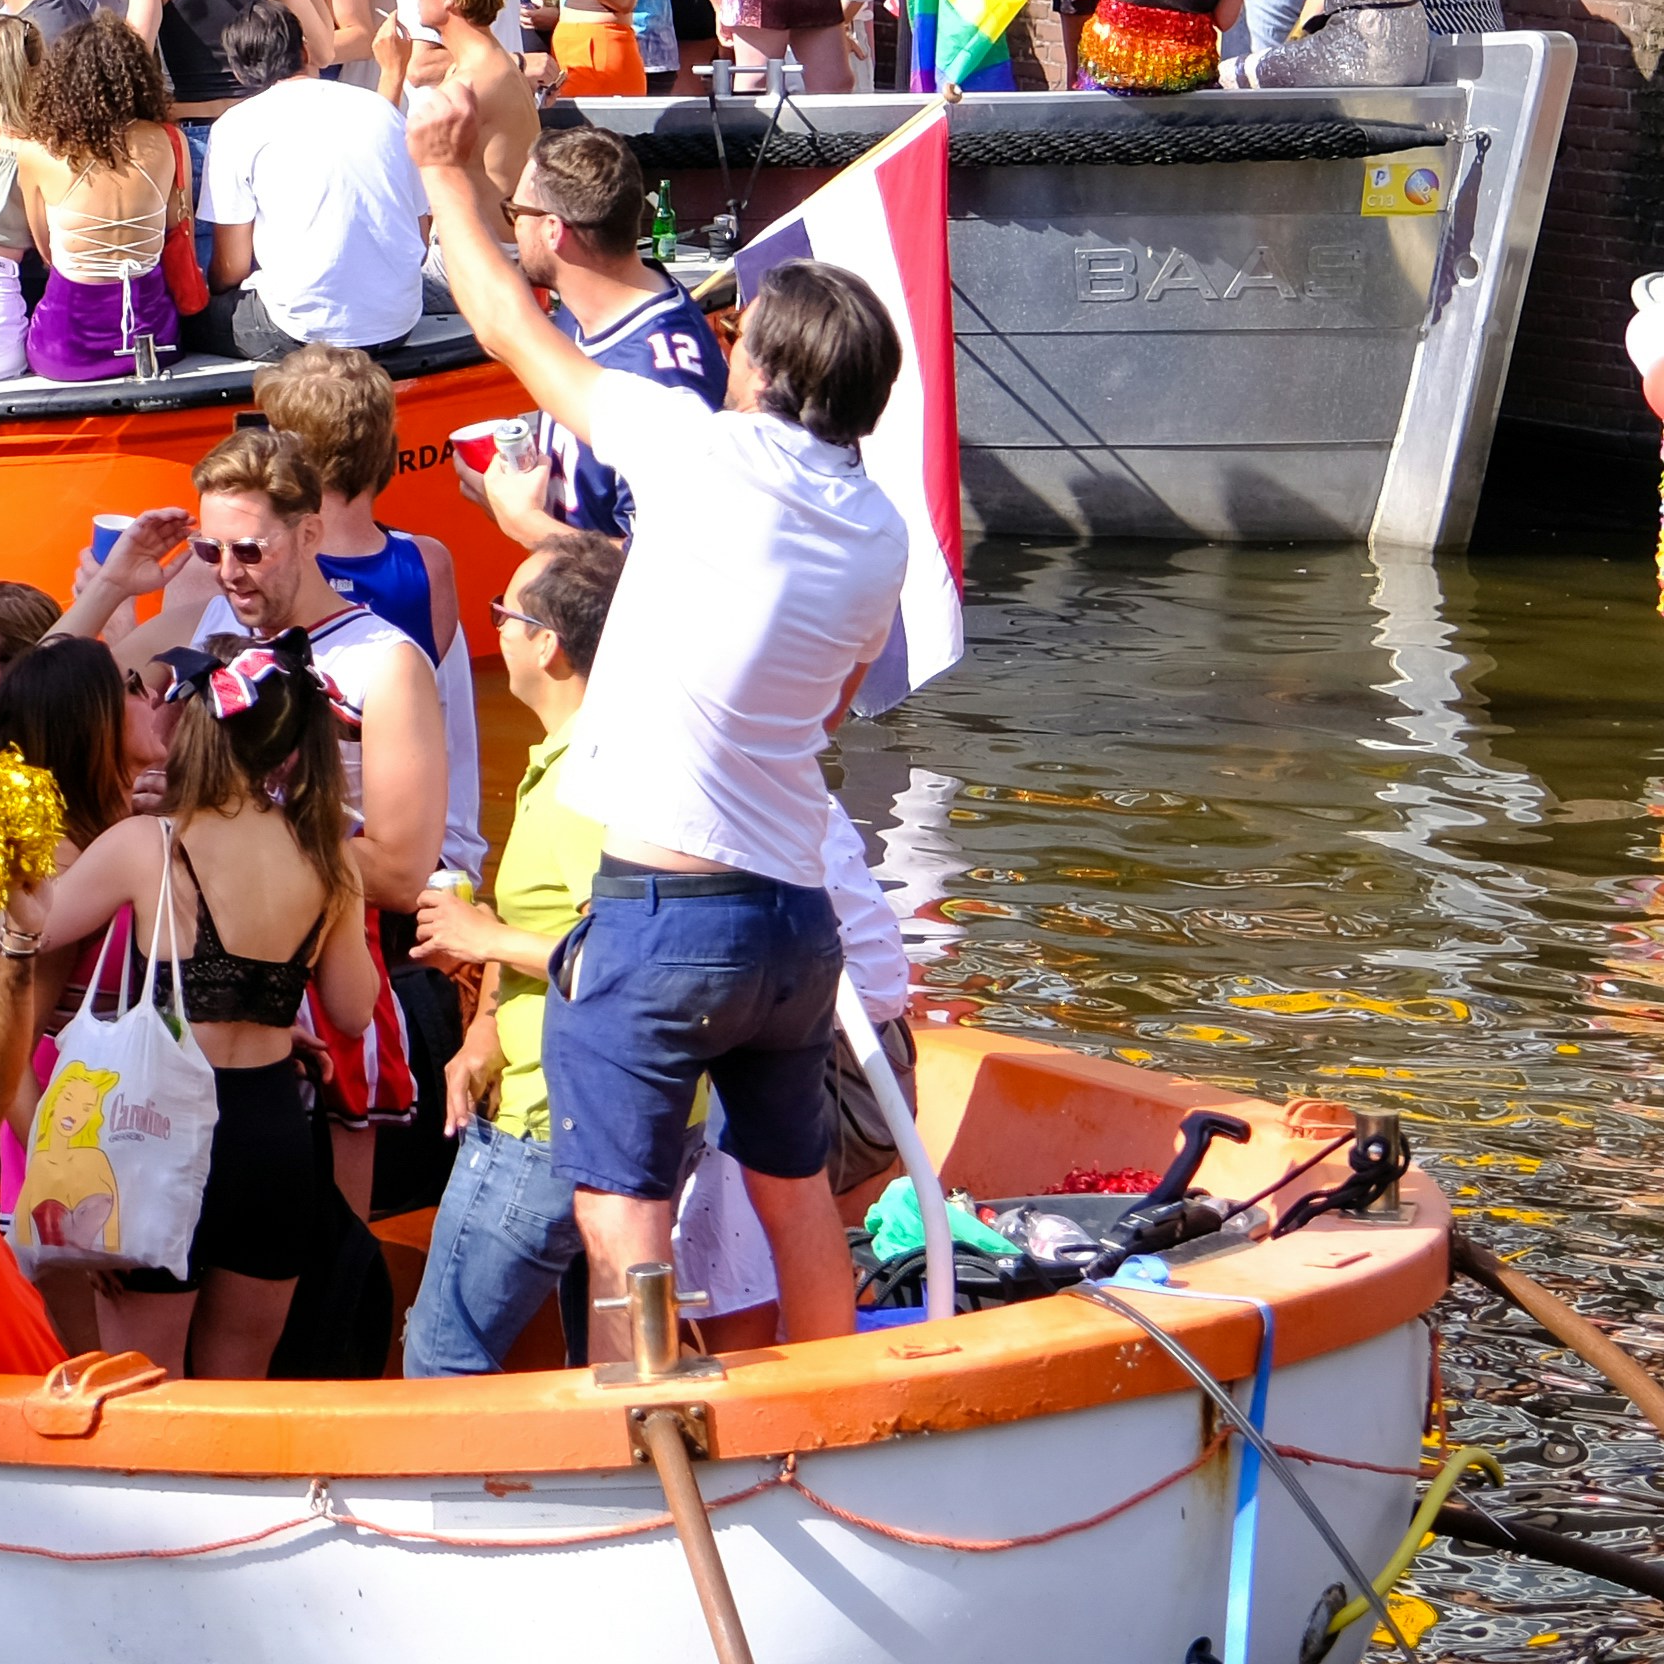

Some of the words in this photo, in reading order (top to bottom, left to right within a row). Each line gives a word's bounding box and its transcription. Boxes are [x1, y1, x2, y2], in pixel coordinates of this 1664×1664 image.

[1074, 244, 1365, 303] BAAS
[647, 331, 706, 377] 12
[393, 444, 457, 478] RDA
[109, 1091, 171, 1141] Caroline
